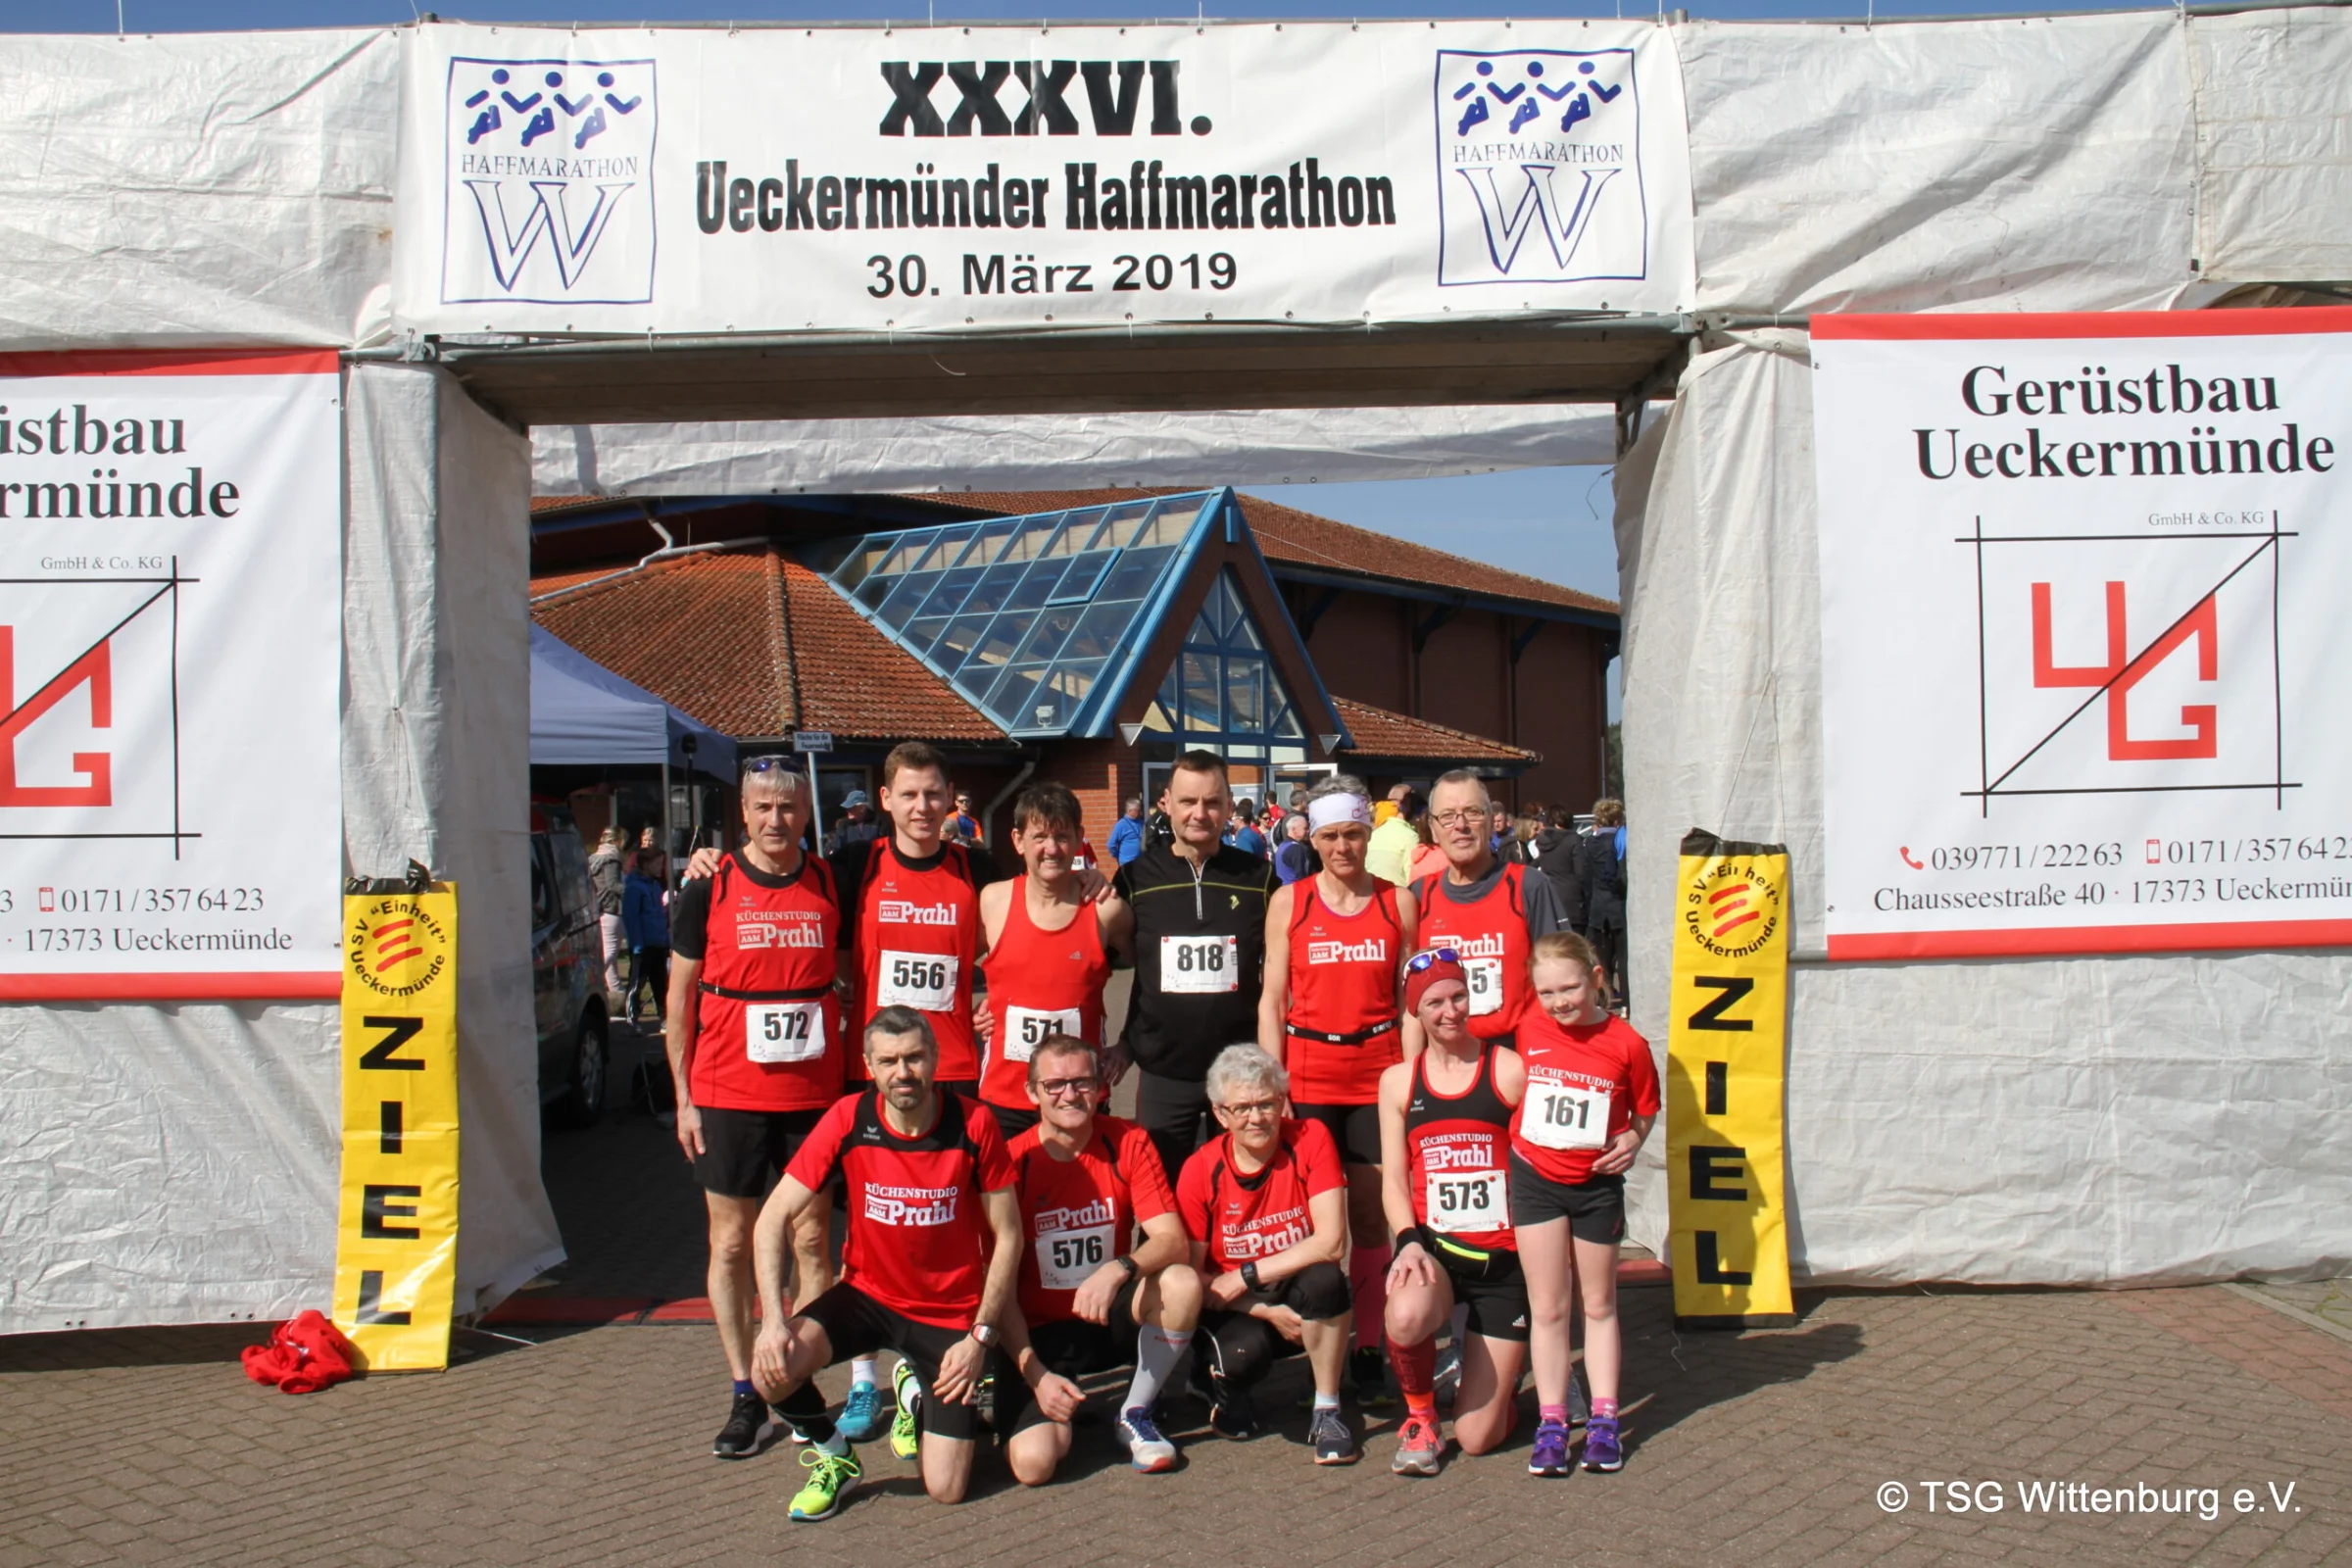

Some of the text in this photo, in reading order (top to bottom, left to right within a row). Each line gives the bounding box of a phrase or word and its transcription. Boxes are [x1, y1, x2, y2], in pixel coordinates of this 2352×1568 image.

[879, 60, 1212, 137] XXXVI.
[462, 154, 638, 177] HAFFMARATHON
[1453, 141, 1623, 164] HAFFMARATHON
[696, 158, 1396, 234] Ueckermünder Haffmarathon
[866, 253, 1237, 299] 30. März 2019
[1961, 364, 2280, 416] Gerüstbau
[1912, 423, 2335, 480] Ueckermünde
[2148, 511, 2264, 526] GmbH & Co. KG
[41, 556, 163, 569] GmbH & Co. KG
[1689, 878, 1707, 905] SV
[1874, 884, 2067, 911] Chausseestraße
[2075, 882, 2106, 906] 40
[2132, 879, 2206, 904] 17373
[736, 910, 820, 922] KÜCHENSTUDIO
[902, 902, 957, 925] Prahl
[25, 927, 293, 952] 17373 Ueckermünde
[351, 918, 368, 946] SV
[763, 922, 824, 948] Prahl
[1450, 933, 1504, 957] Prahl
[1686, 910, 1777, 957] Ueckermünde
[1177, 944, 1223, 972] 818
[1331, 939, 1386, 962] Prahl
[351, 950, 445, 997] Ueckermünde
[893, 960, 945, 991] 556
[764, 1010, 808, 1041] 572
[1022, 1015, 1062, 1045] 571
[1529, 1064, 1614, 1090] KÜCHENSTUDIO
[1544, 1095, 1590, 1129] 161
[1419, 1133, 1493, 1148] KÜCHENSTUDIO
[1689, 975, 1754, 1286] ZIEL
[355, 1016, 425, 1325] ZIEL
[1441, 1144, 1493, 1169] Prahl
[865, 1182, 958, 1200] KÜCHENSTUDIO
[1439, 1180, 1490, 1211] 573
[888, 1198, 956, 1226] Prahl
[1058, 1197, 1114, 1231] Prahl
[1248, 1216, 1310, 1257] Prahl
[1053, 1235, 1102, 1268] 576
